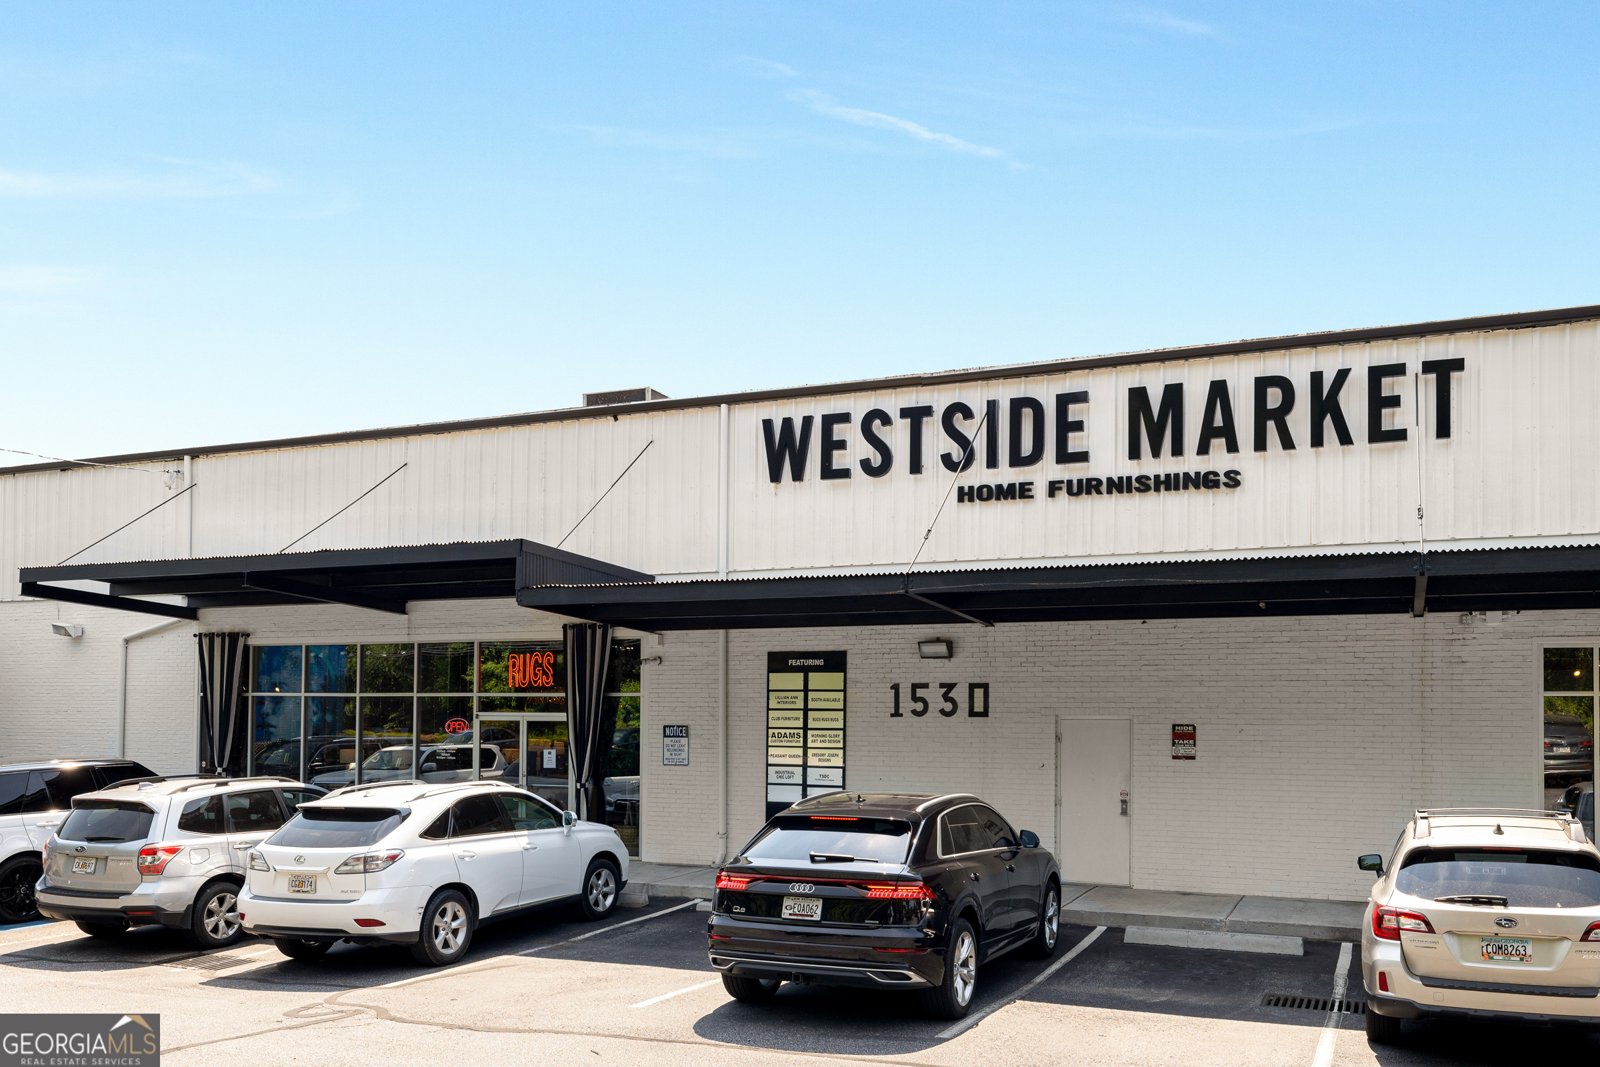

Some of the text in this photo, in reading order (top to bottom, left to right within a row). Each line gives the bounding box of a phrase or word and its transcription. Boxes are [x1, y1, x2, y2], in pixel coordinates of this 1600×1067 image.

[762, 358, 1465, 483] WESTSIDE MARKET
[957, 469, 1242, 503] HOME FURNISHINGS
[508, 651, 554, 688] RUGS
[890, 682, 989, 717] 1530
[446, 721, 468, 732] OPEN
[665, 727, 687, 736] NOTICE
